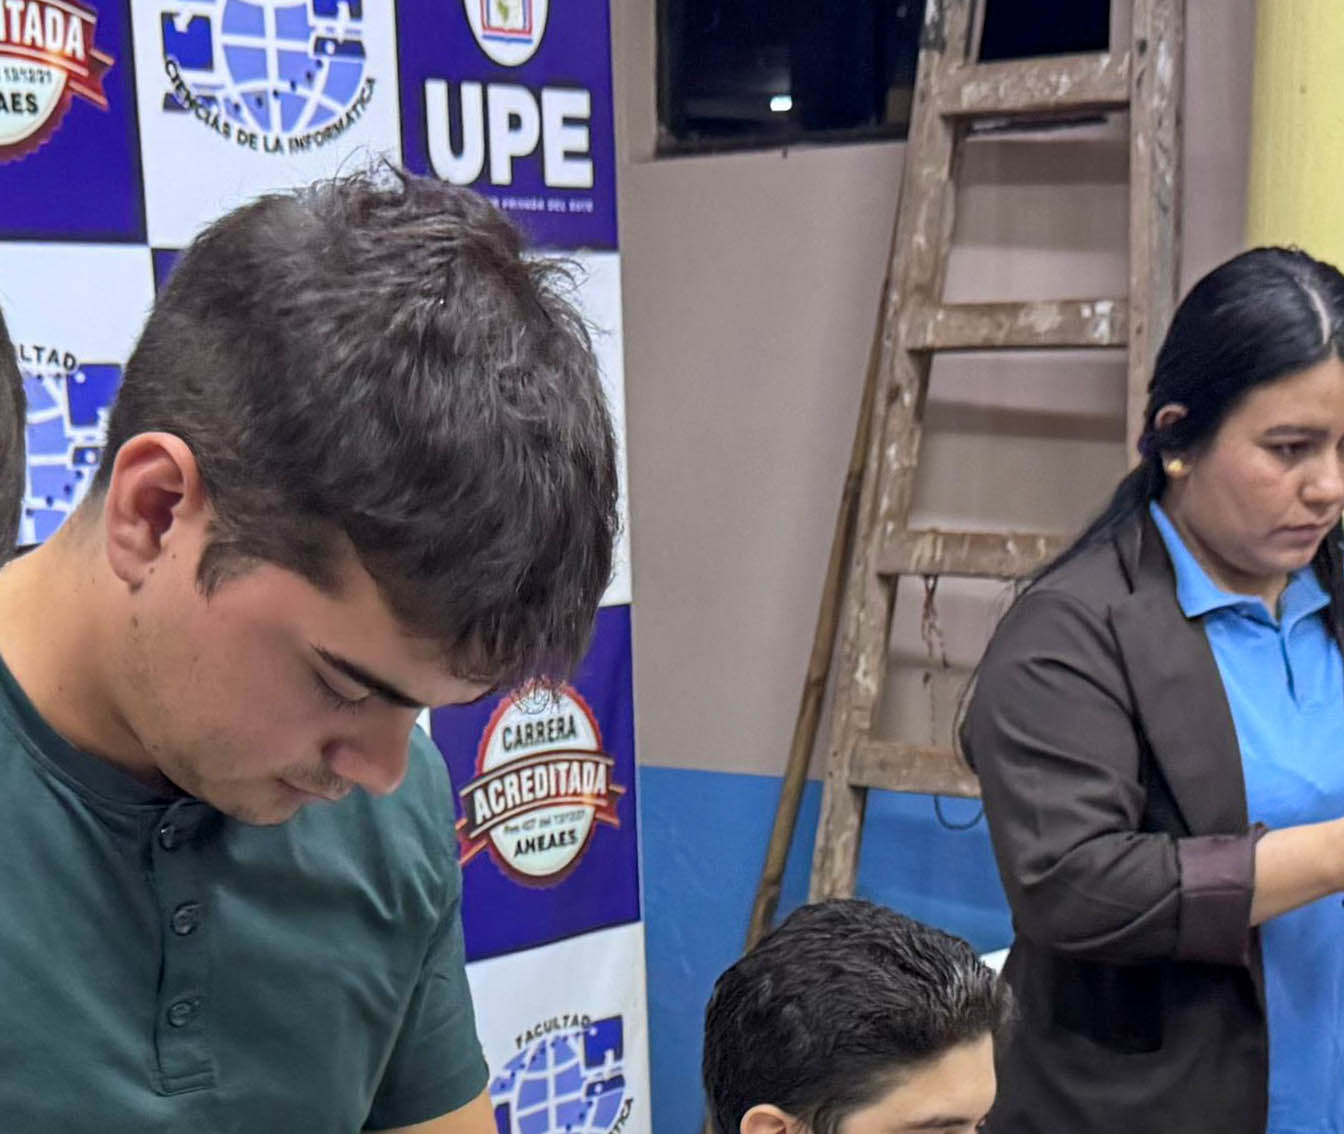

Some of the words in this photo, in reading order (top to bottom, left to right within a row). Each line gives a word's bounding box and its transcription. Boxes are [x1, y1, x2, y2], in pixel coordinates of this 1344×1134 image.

[237, 129, 258, 151] DE
[263, 134, 285, 153] LA
[424, 78, 594, 189] UPE
[502, 715, 577, 752] CARRERA
[473, 760, 607, 825] ACREDITADA
[515, 1015, 592, 1050] FACULTAD
